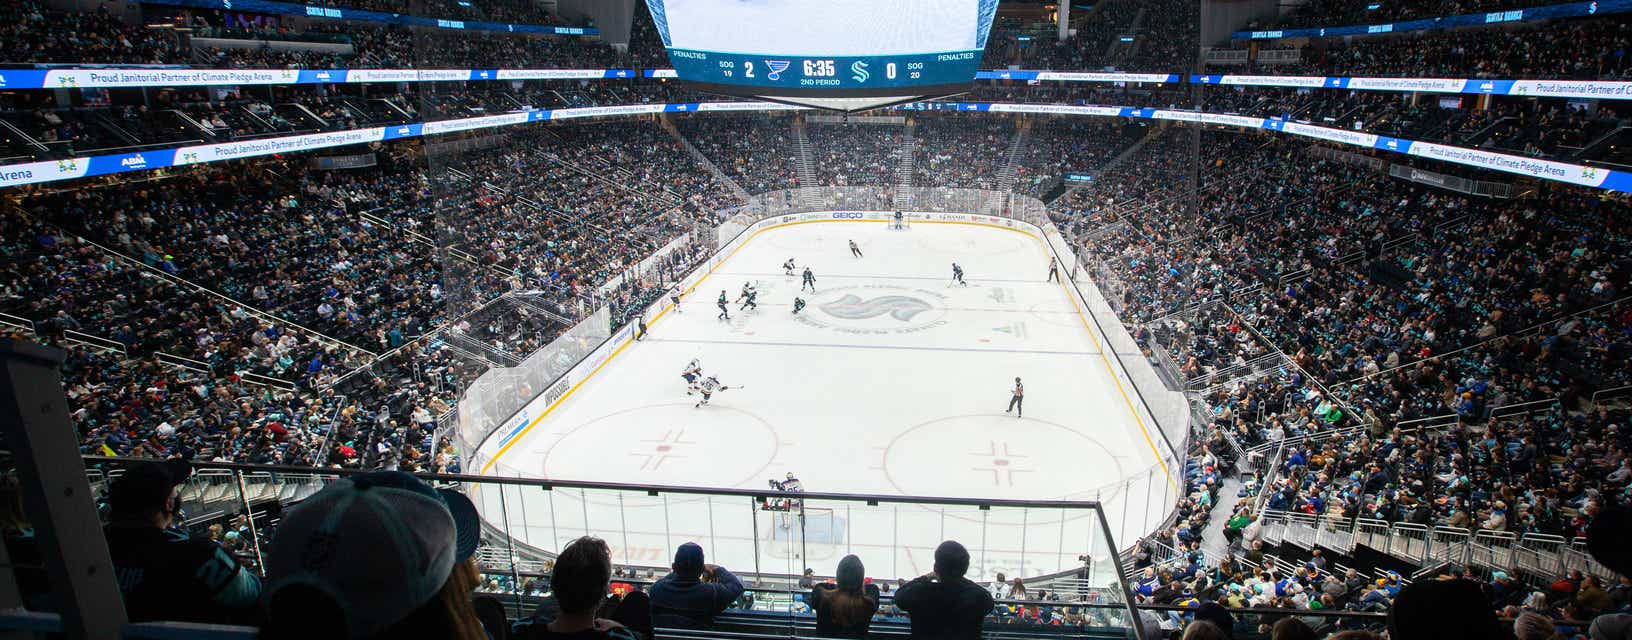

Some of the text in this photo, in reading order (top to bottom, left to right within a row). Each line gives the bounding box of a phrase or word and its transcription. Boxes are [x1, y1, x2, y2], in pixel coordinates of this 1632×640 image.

[673, 50, 706, 59] PENALTIES
[938, 52, 974, 61] PENALTIES
[744, 61, 755, 78] 2
[804, 60, 835, 76] 6:35
[886, 62, 896, 79] 0
[90, 72, 273, 83] Proud Janitorial Partner of Climate Pledge Arena
[1536, 83, 1556, 93] Proud
[1556, 83, 1586, 94] Janitorial
[1587, 85, 1614, 94] Partner
[1616, 85, 1625, 94] of
[215, 146, 238, 156] Proud
[239, 143, 271, 154] Janitorial
[271, 141, 295, 151] Partner
[1468, 152, 1488, 164] Partner
[1496, 156, 1520, 168] Climate
[1520, 161, 1543, 175] Pledge
[1544, 165, 1566, 177] Arena
[0, 170, 33, 181] Arena
